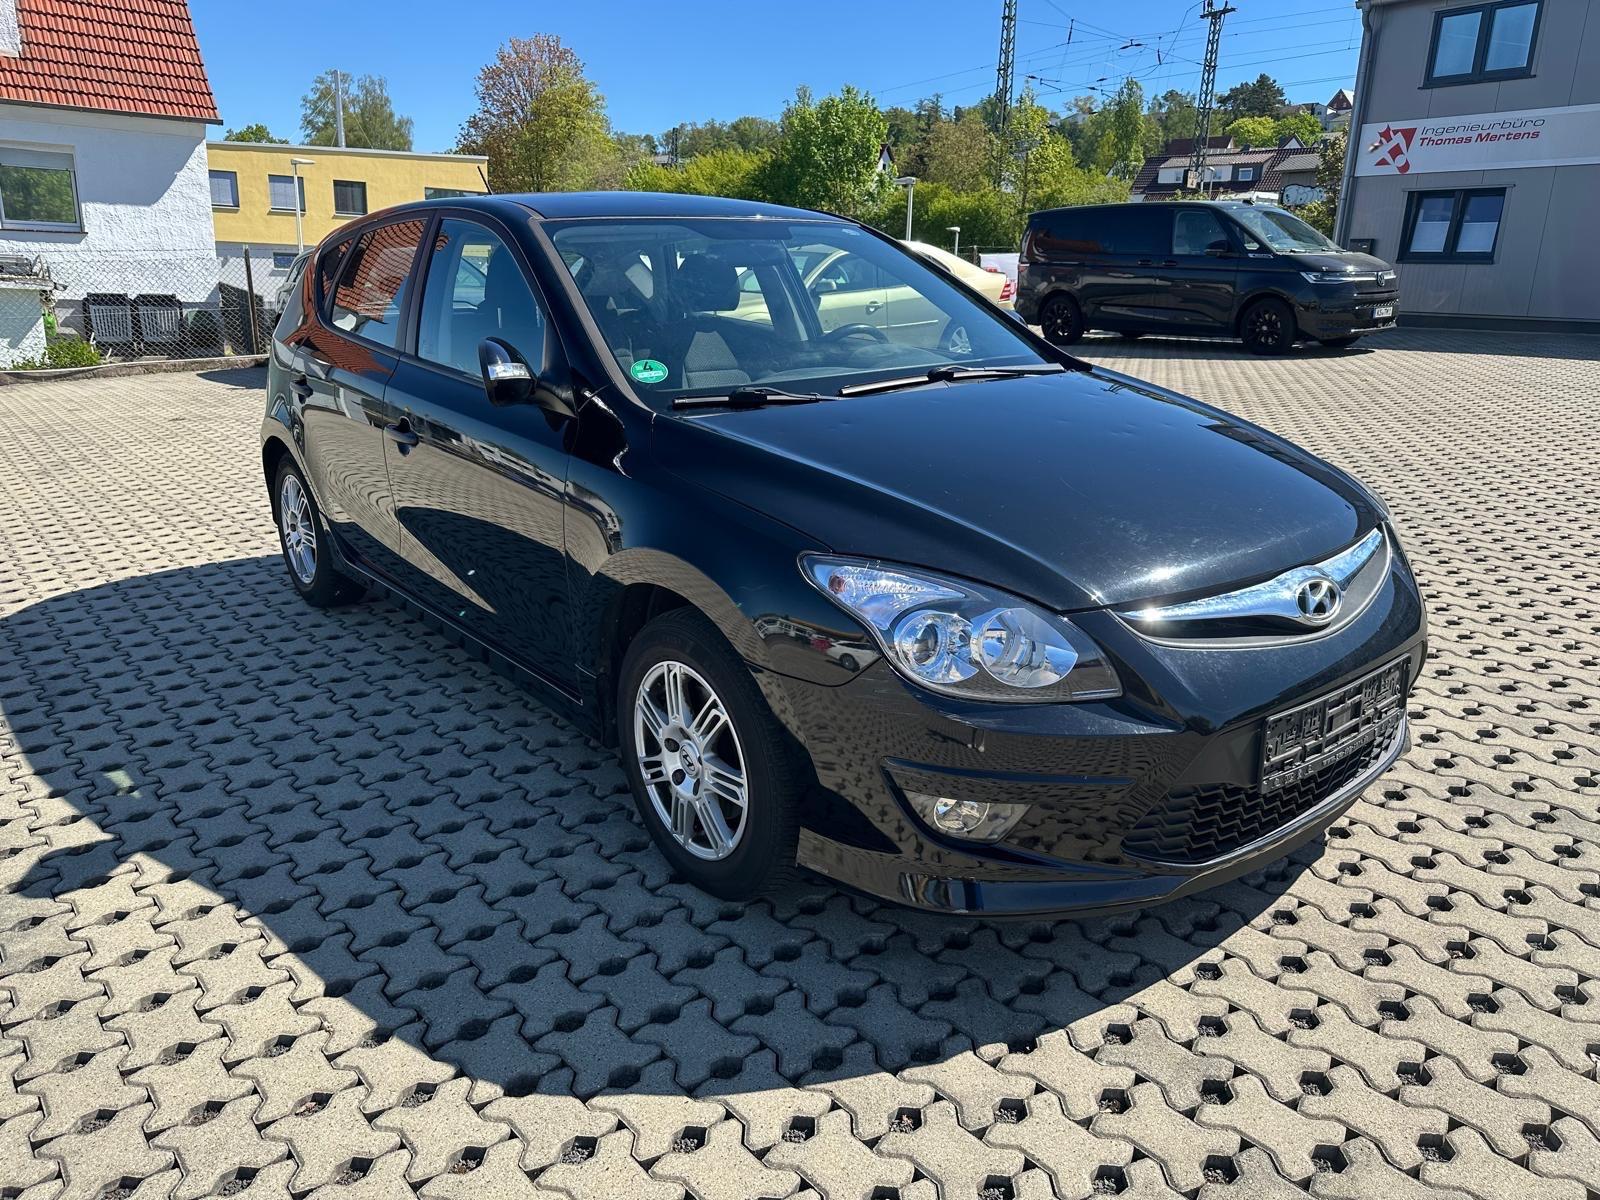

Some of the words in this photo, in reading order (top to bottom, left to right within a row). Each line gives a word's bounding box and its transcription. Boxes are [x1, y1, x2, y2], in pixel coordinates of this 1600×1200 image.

[1421, 118, 1545, 136] Ingenieurbüro
[1420, 136, 1472, 146] Thomas
[1475, 130, 1540, 142] Mertens
[643, 361, 653, 371] 4
